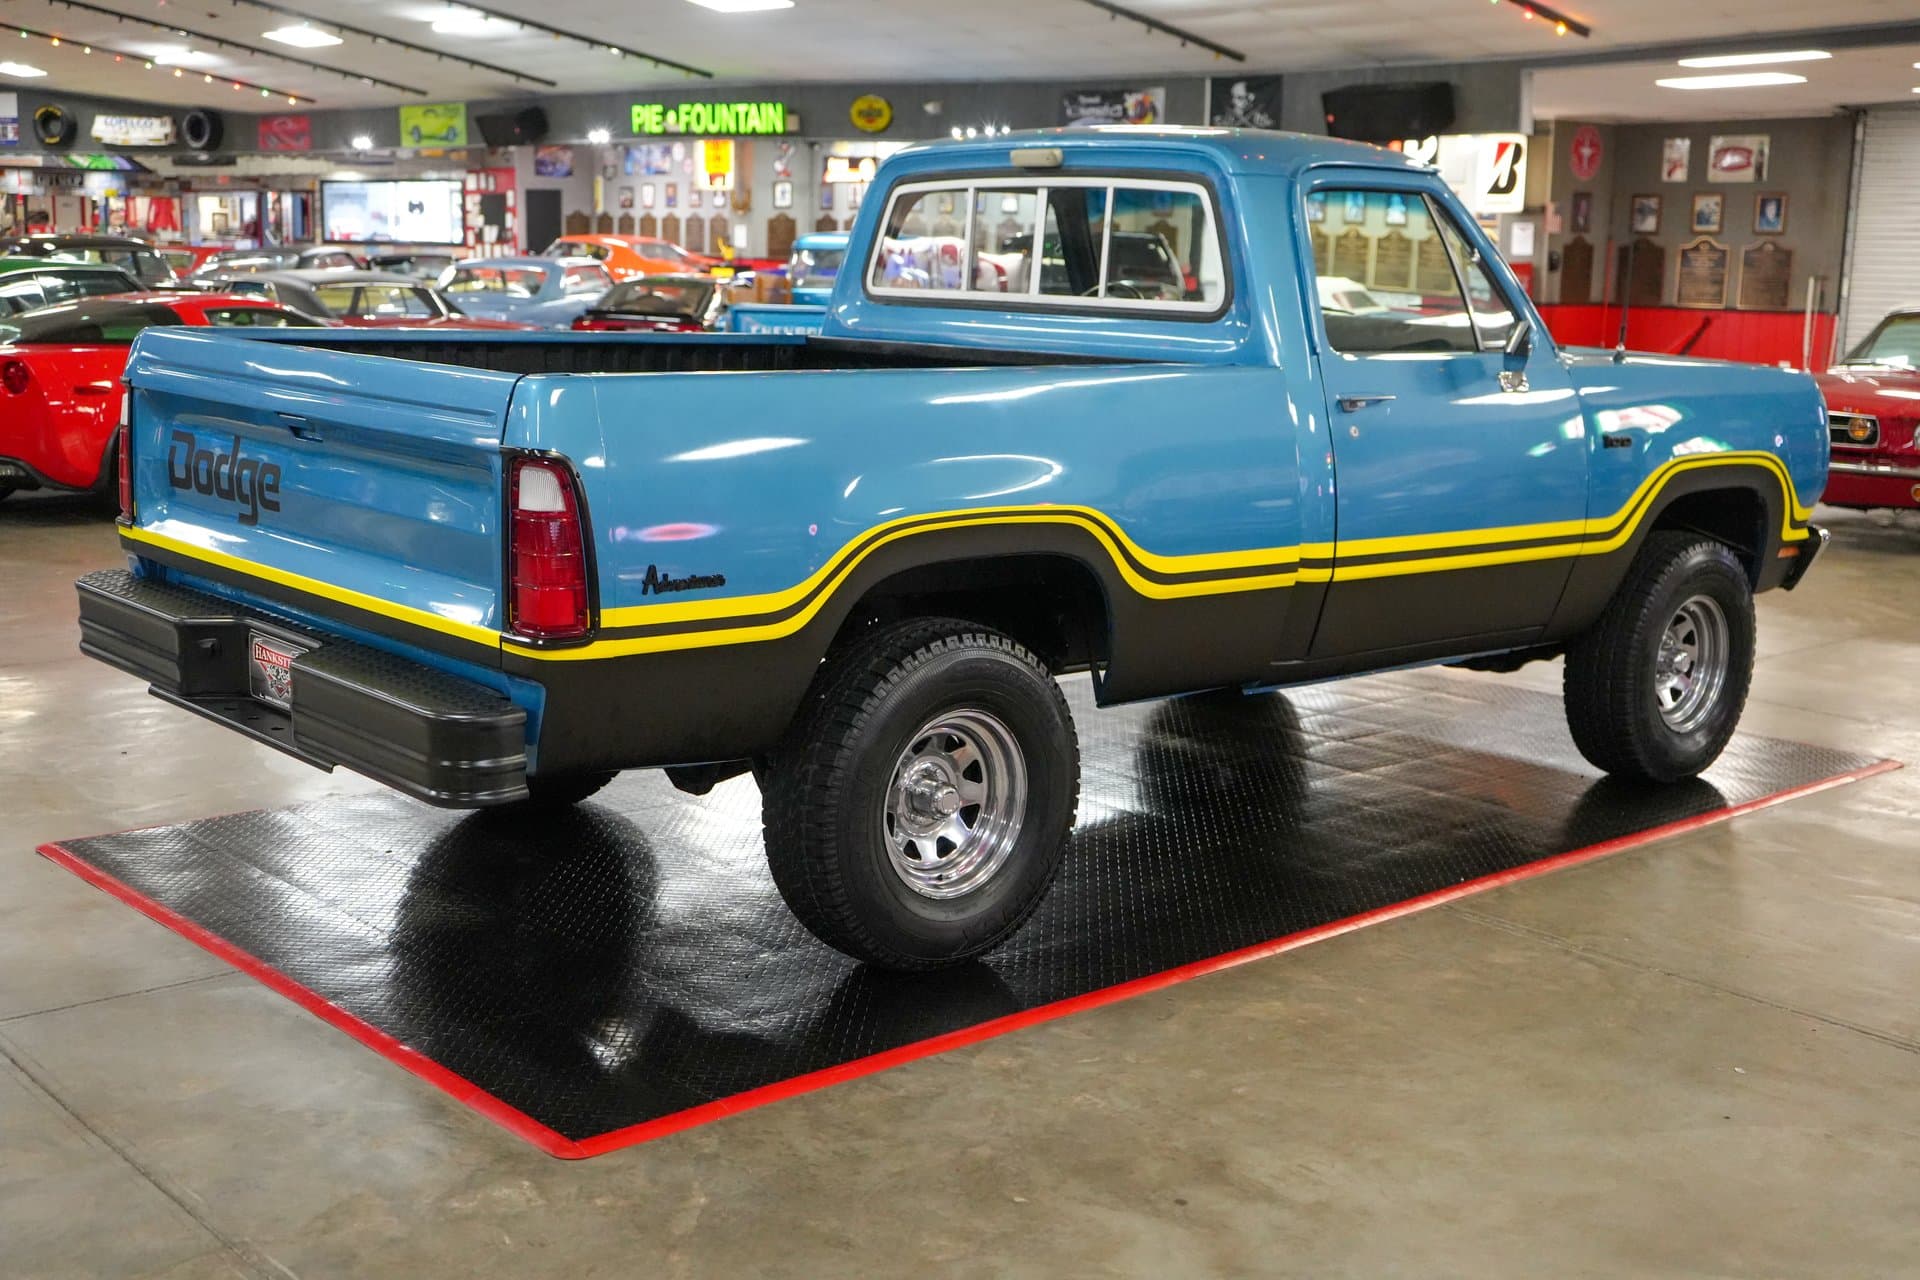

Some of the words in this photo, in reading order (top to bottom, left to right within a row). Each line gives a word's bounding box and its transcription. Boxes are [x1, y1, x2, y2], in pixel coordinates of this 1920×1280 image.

[632, 104, 664, 134] PIE
[678, 103, 785, 134] FOUNTAIN
[168, 429, 281, 526] Dodge
